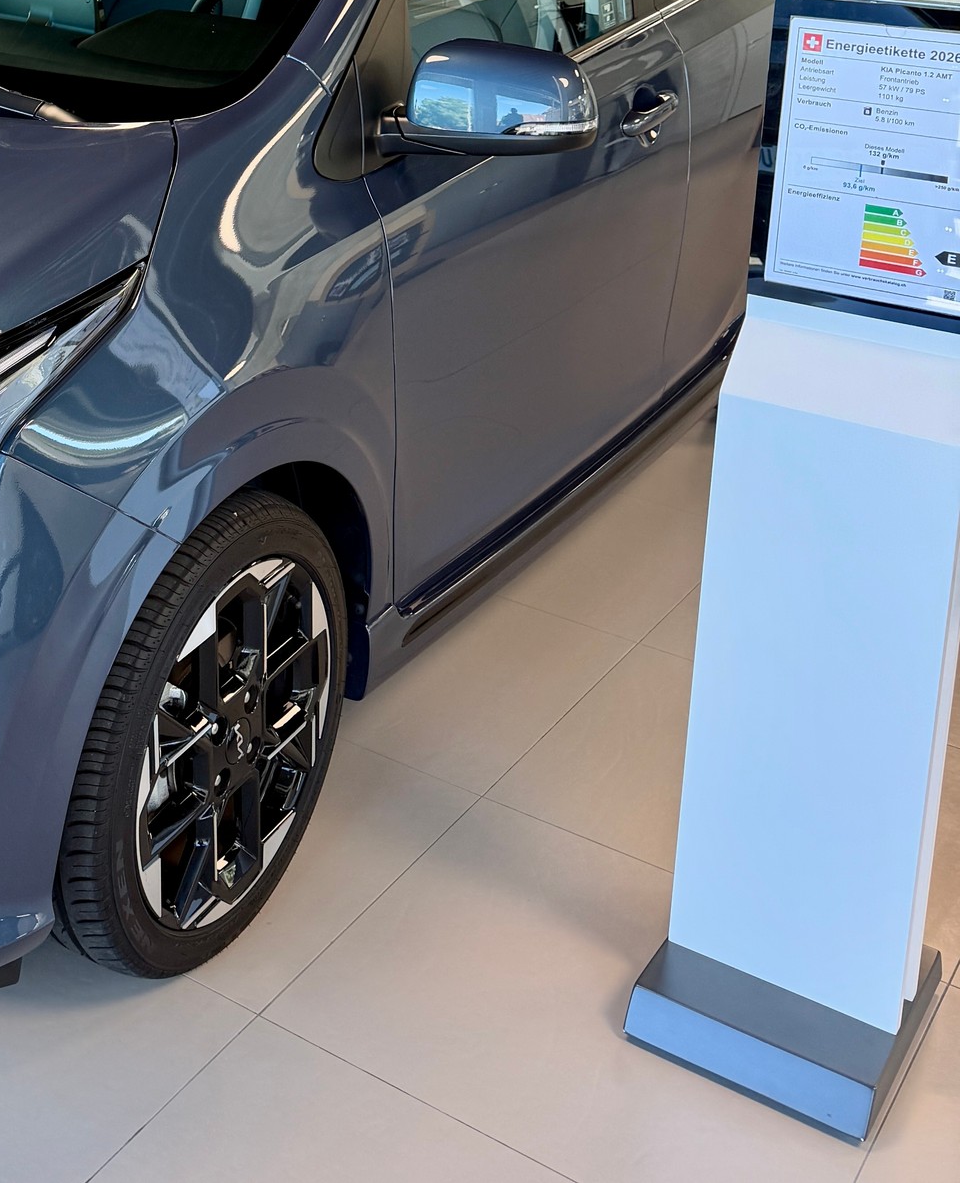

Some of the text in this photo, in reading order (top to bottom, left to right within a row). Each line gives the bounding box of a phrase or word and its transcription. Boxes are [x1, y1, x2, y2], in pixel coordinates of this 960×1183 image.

[826, 39, 960, 64] Energieetikette 2026
[800, 66, 835, 75] Antriebsart
[880, 66, 894, 74] KIA
[895, 68, 922, 77] Picanto
[800, 75, 826, 84] Leistung
[880, 75, 920, 86] Frontantrieb
[798, 83, 837, 93] Leergewicht
[797, 98, 832, 108] Verbrauch
[895, 95, 904, 103] kg
[876, 108, 899, 116] Benzin
[904, 118, 915, 126] km
[864, 143, 905, 154] Dieses Modell
[787, 188, 840, 202] Energieeffizienz
[904, 238, 910, 246] D
[947, 254, 957, 265] E
[915, 269, 922, 277] G
